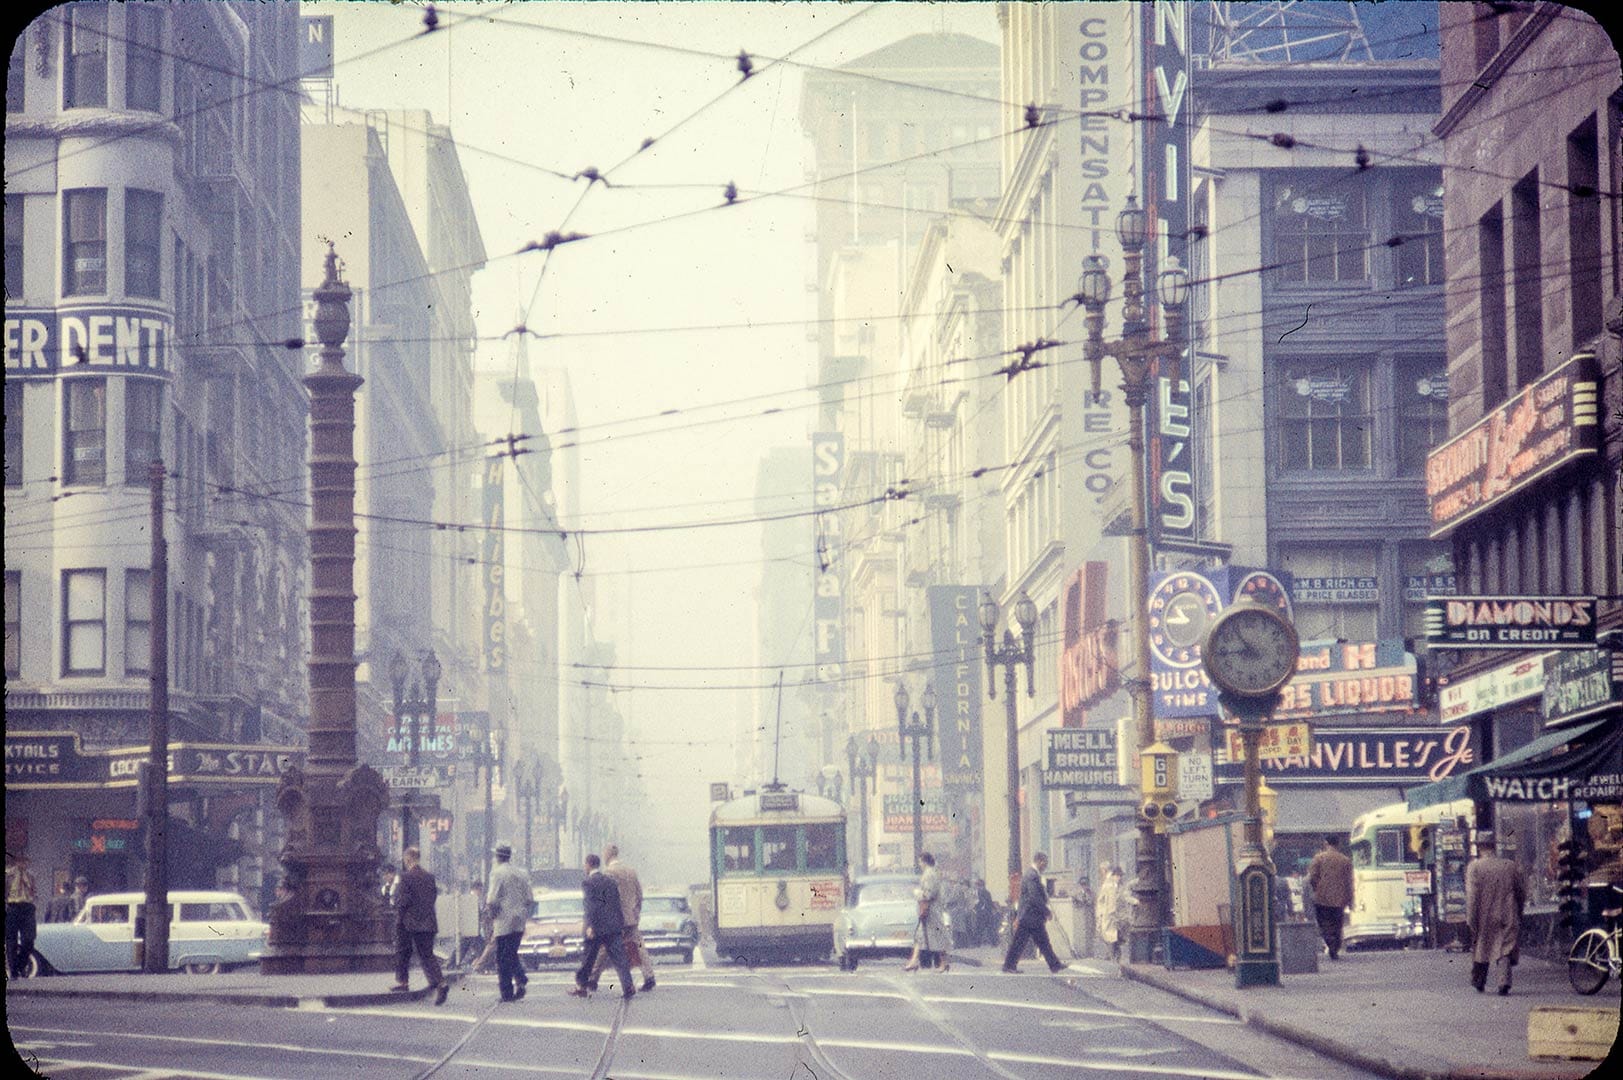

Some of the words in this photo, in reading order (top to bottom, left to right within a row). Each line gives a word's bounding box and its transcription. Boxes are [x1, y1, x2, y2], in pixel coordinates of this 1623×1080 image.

[1447, 601, 1592, 626] DIAMONDS
[1498, 629, 1560, 641] CREDIT
[956, 595, 971, 768] CALIFORNIA
[1163, 692, 1207, 707] TIME
[1484, 776, 1569, 799] WATCH
